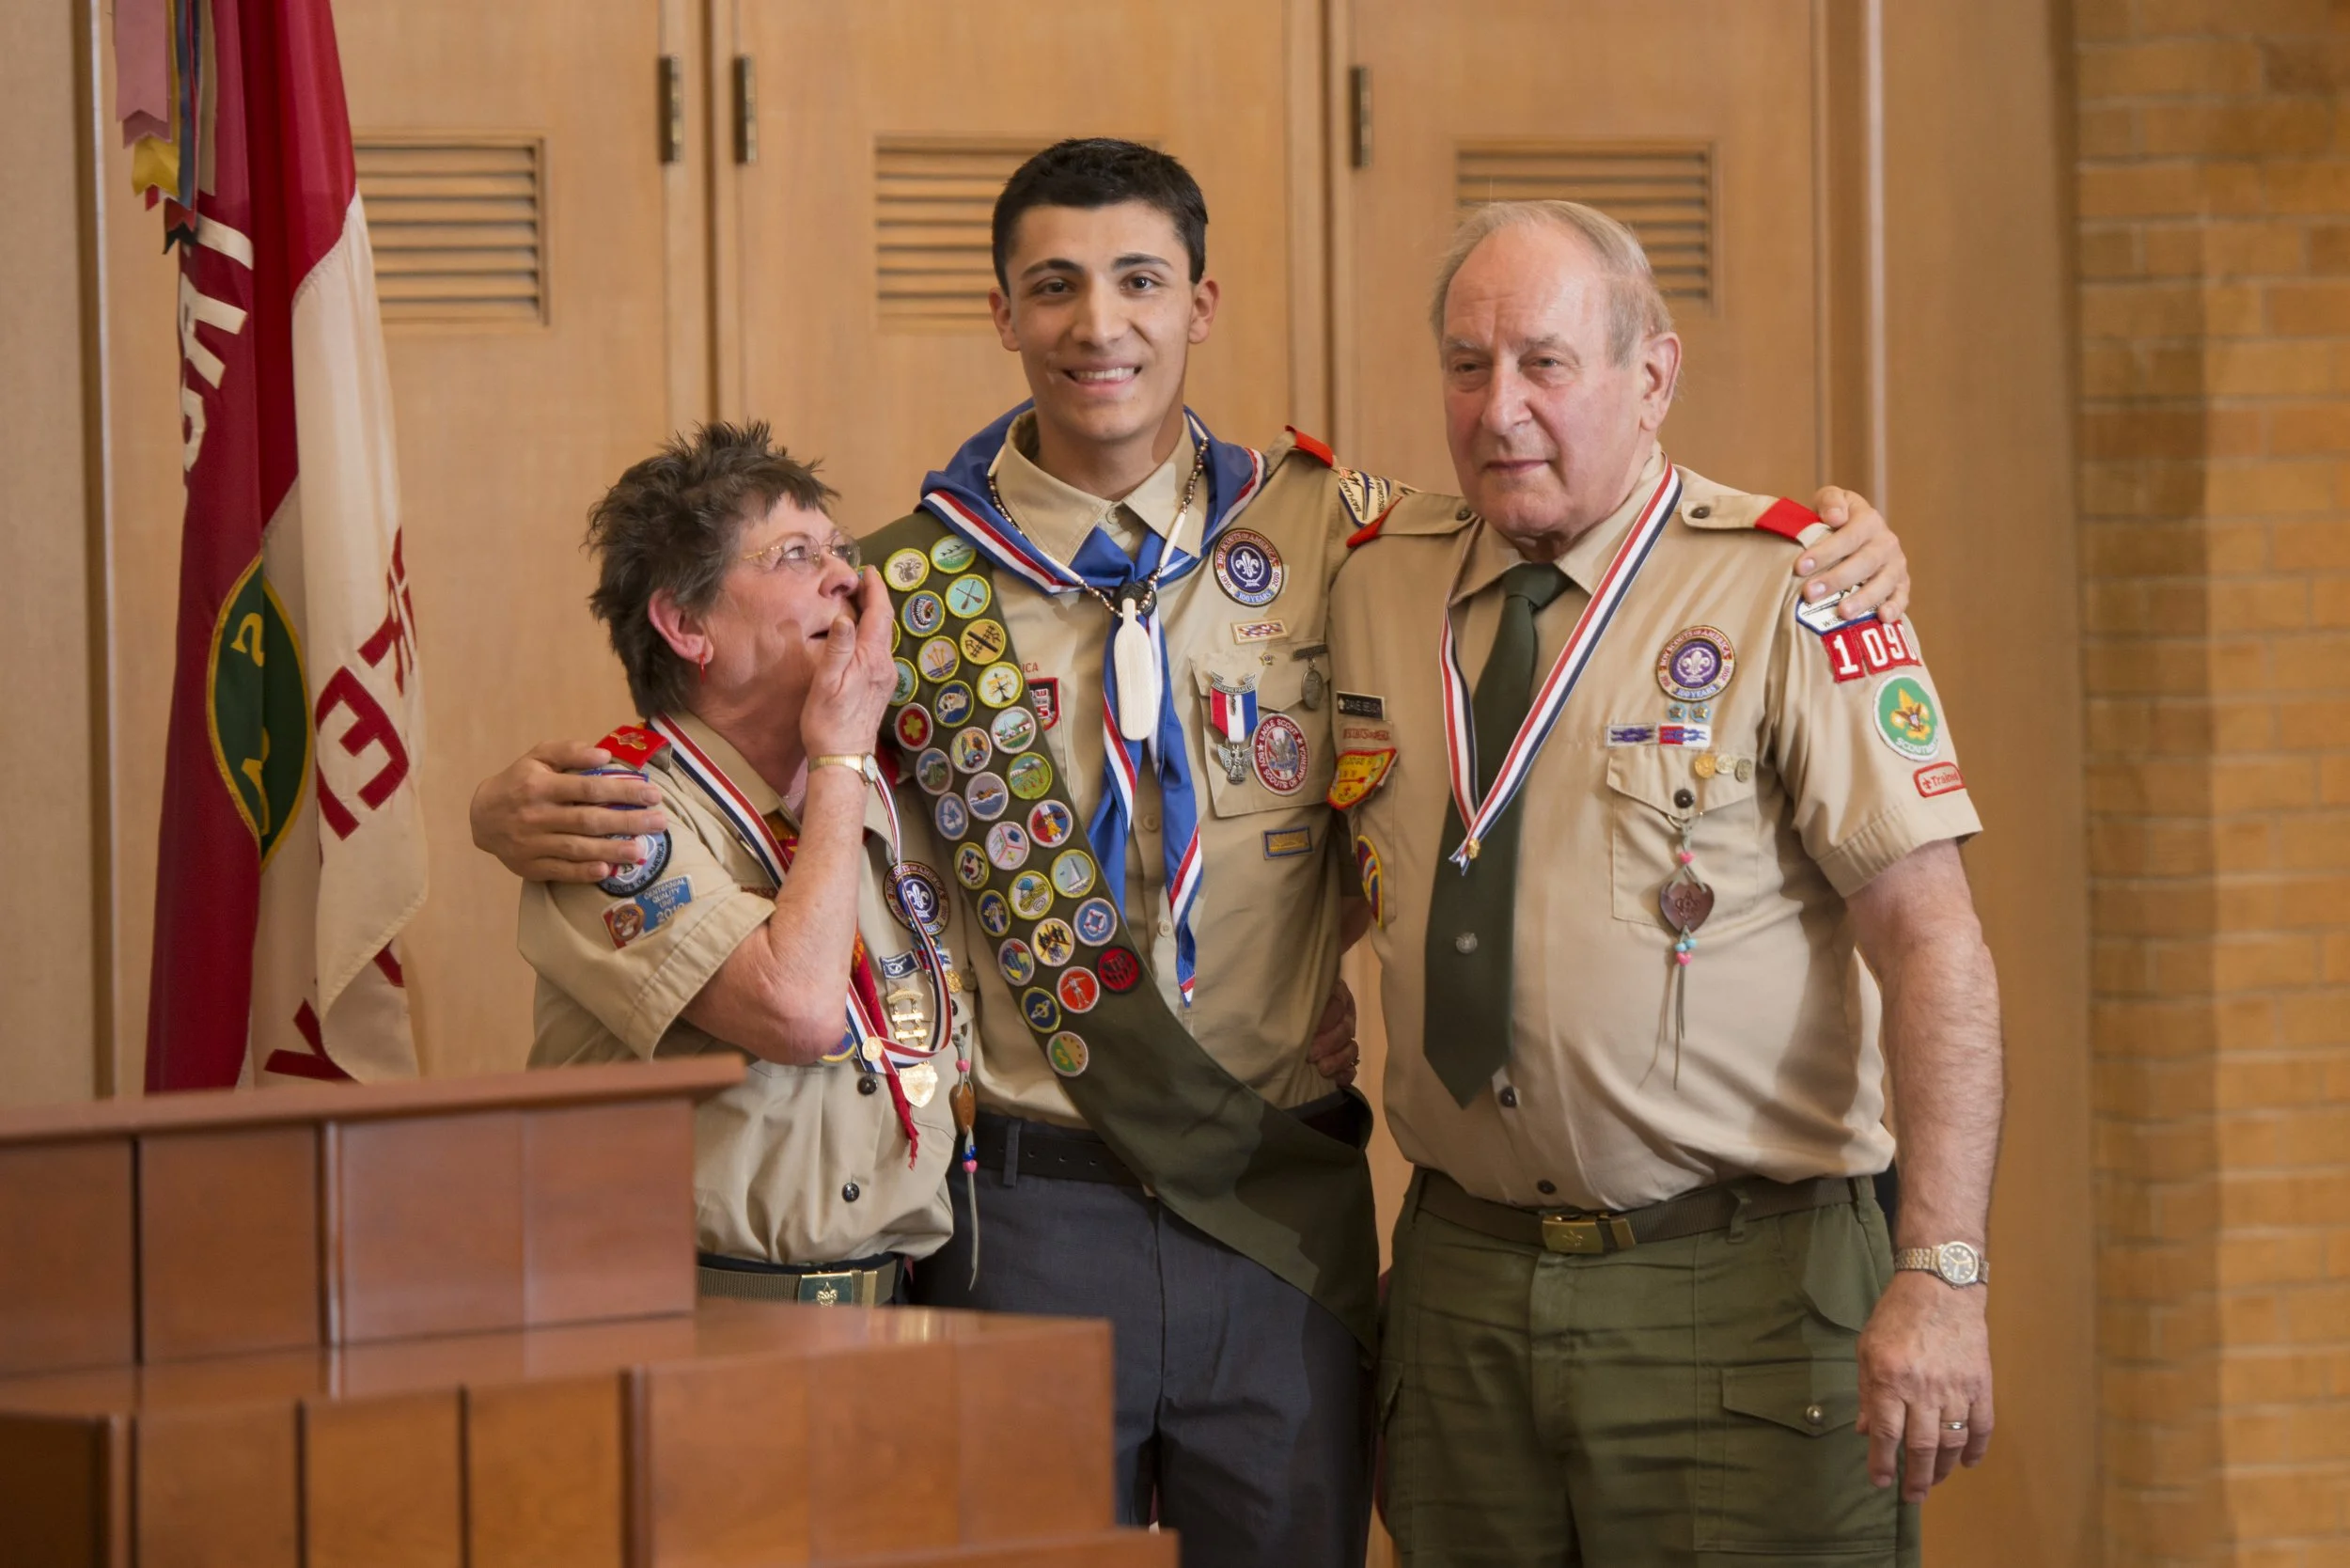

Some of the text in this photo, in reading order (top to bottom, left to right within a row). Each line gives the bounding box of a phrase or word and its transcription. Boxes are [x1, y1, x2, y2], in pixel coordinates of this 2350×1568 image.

[1272, 572, 1280, 587] 2010
[1250, 590, 1271, 602] YEARS
[1260, 719, 1298, 741] EAGLE SCOUT
[1263, 769, 1288, 788] SCOUTS
[1297, 746, 1307, 780] AMERICA
[649, 842, 666, 874] AMERICA
